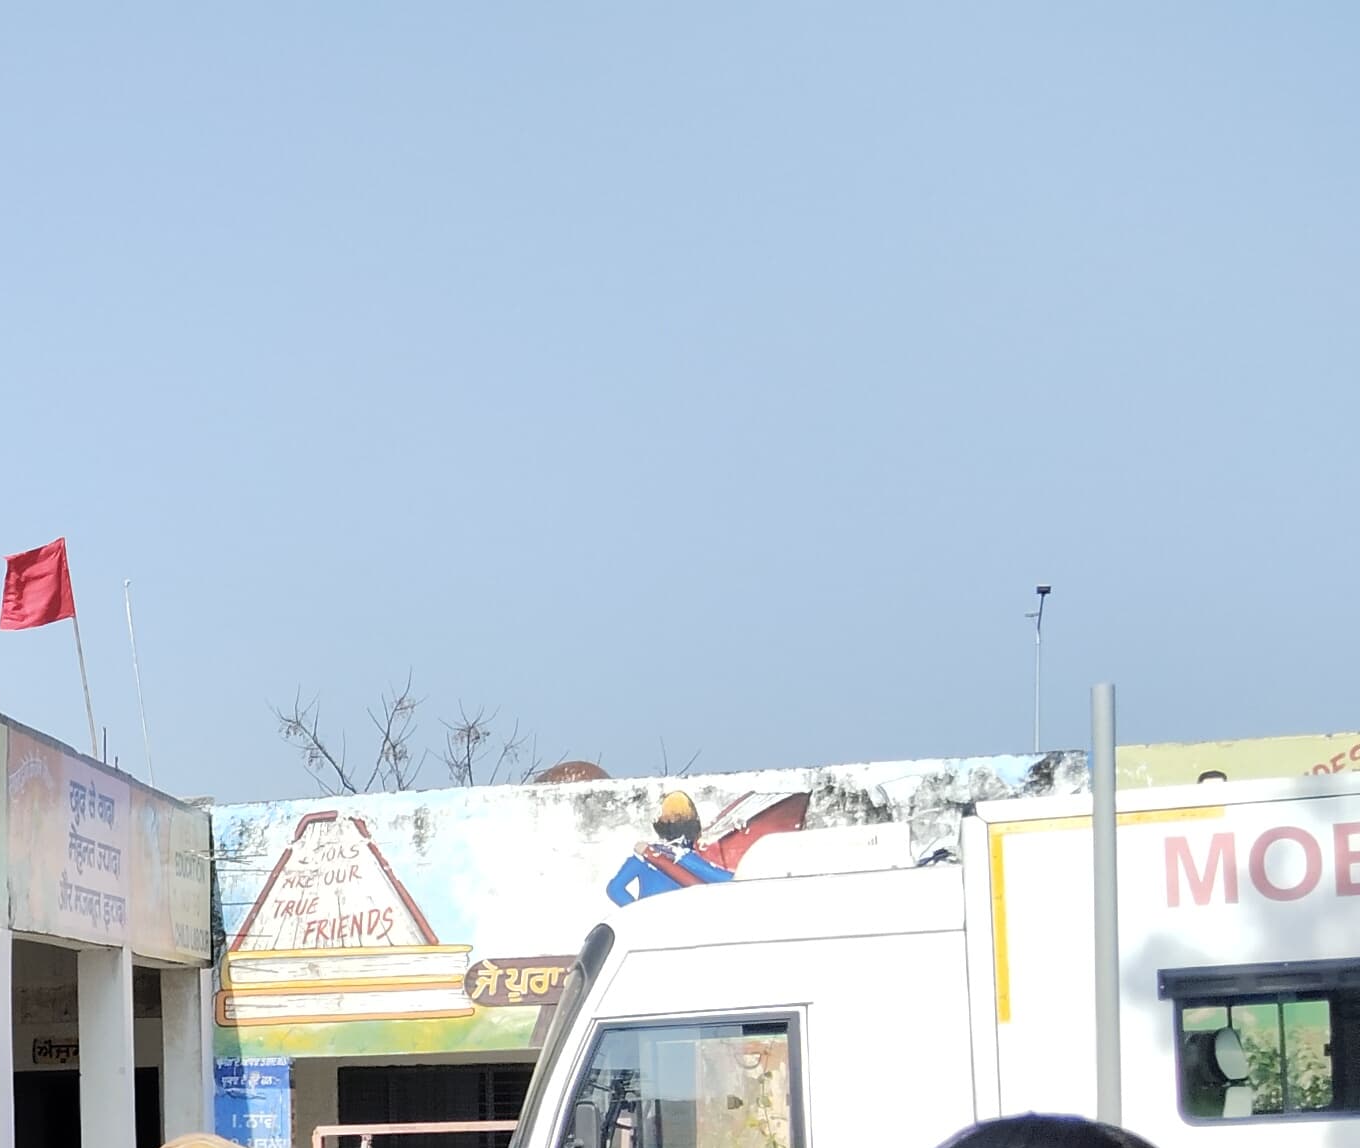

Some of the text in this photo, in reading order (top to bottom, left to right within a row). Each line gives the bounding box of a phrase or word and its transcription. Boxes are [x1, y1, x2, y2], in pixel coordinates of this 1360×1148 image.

[323, 864, 363, 886] OUR
[273, 896, 320, 919] TRUE
[302, 906, 394, 945] FRIENDS
